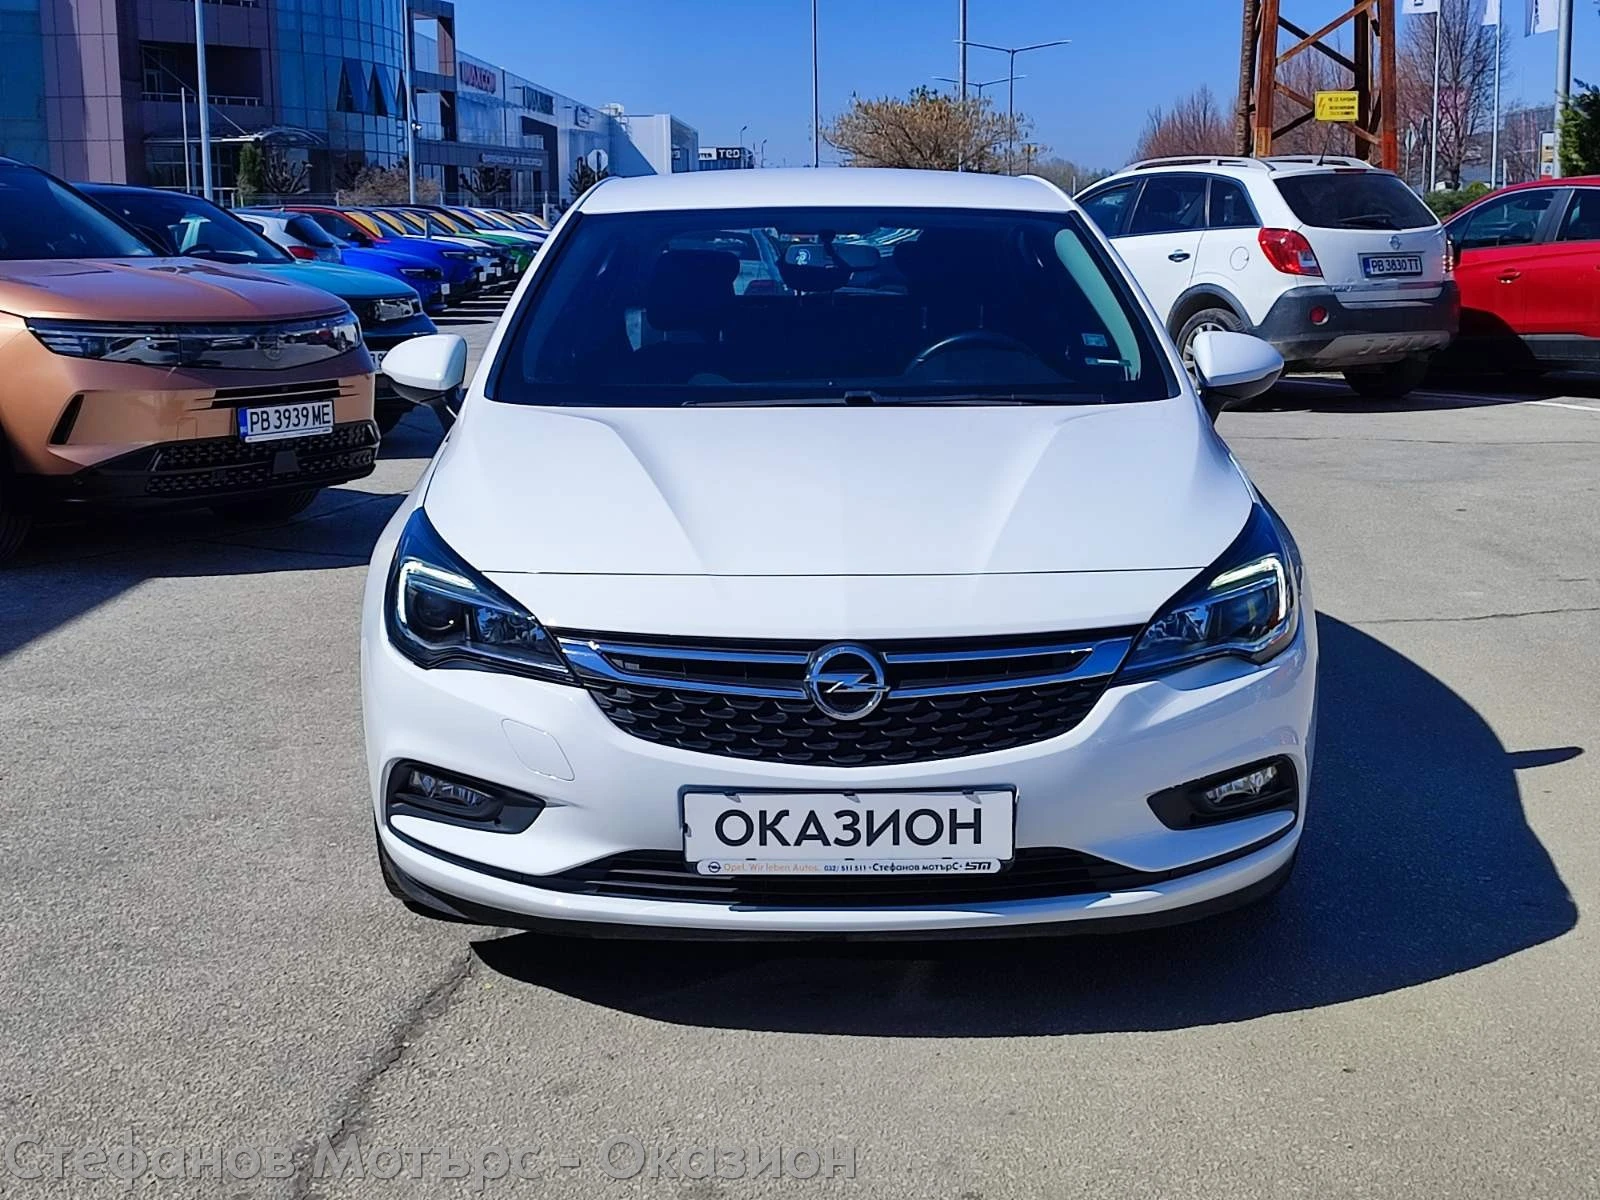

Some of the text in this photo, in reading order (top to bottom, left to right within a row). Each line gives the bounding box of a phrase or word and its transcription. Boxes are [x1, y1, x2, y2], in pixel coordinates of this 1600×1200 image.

[1371, 258, 1419, 272] PB 3830 TT
[250, 404, 331, 432] PB 3939 ME
[714, 808, 982, 847] ОКАЗИОН
